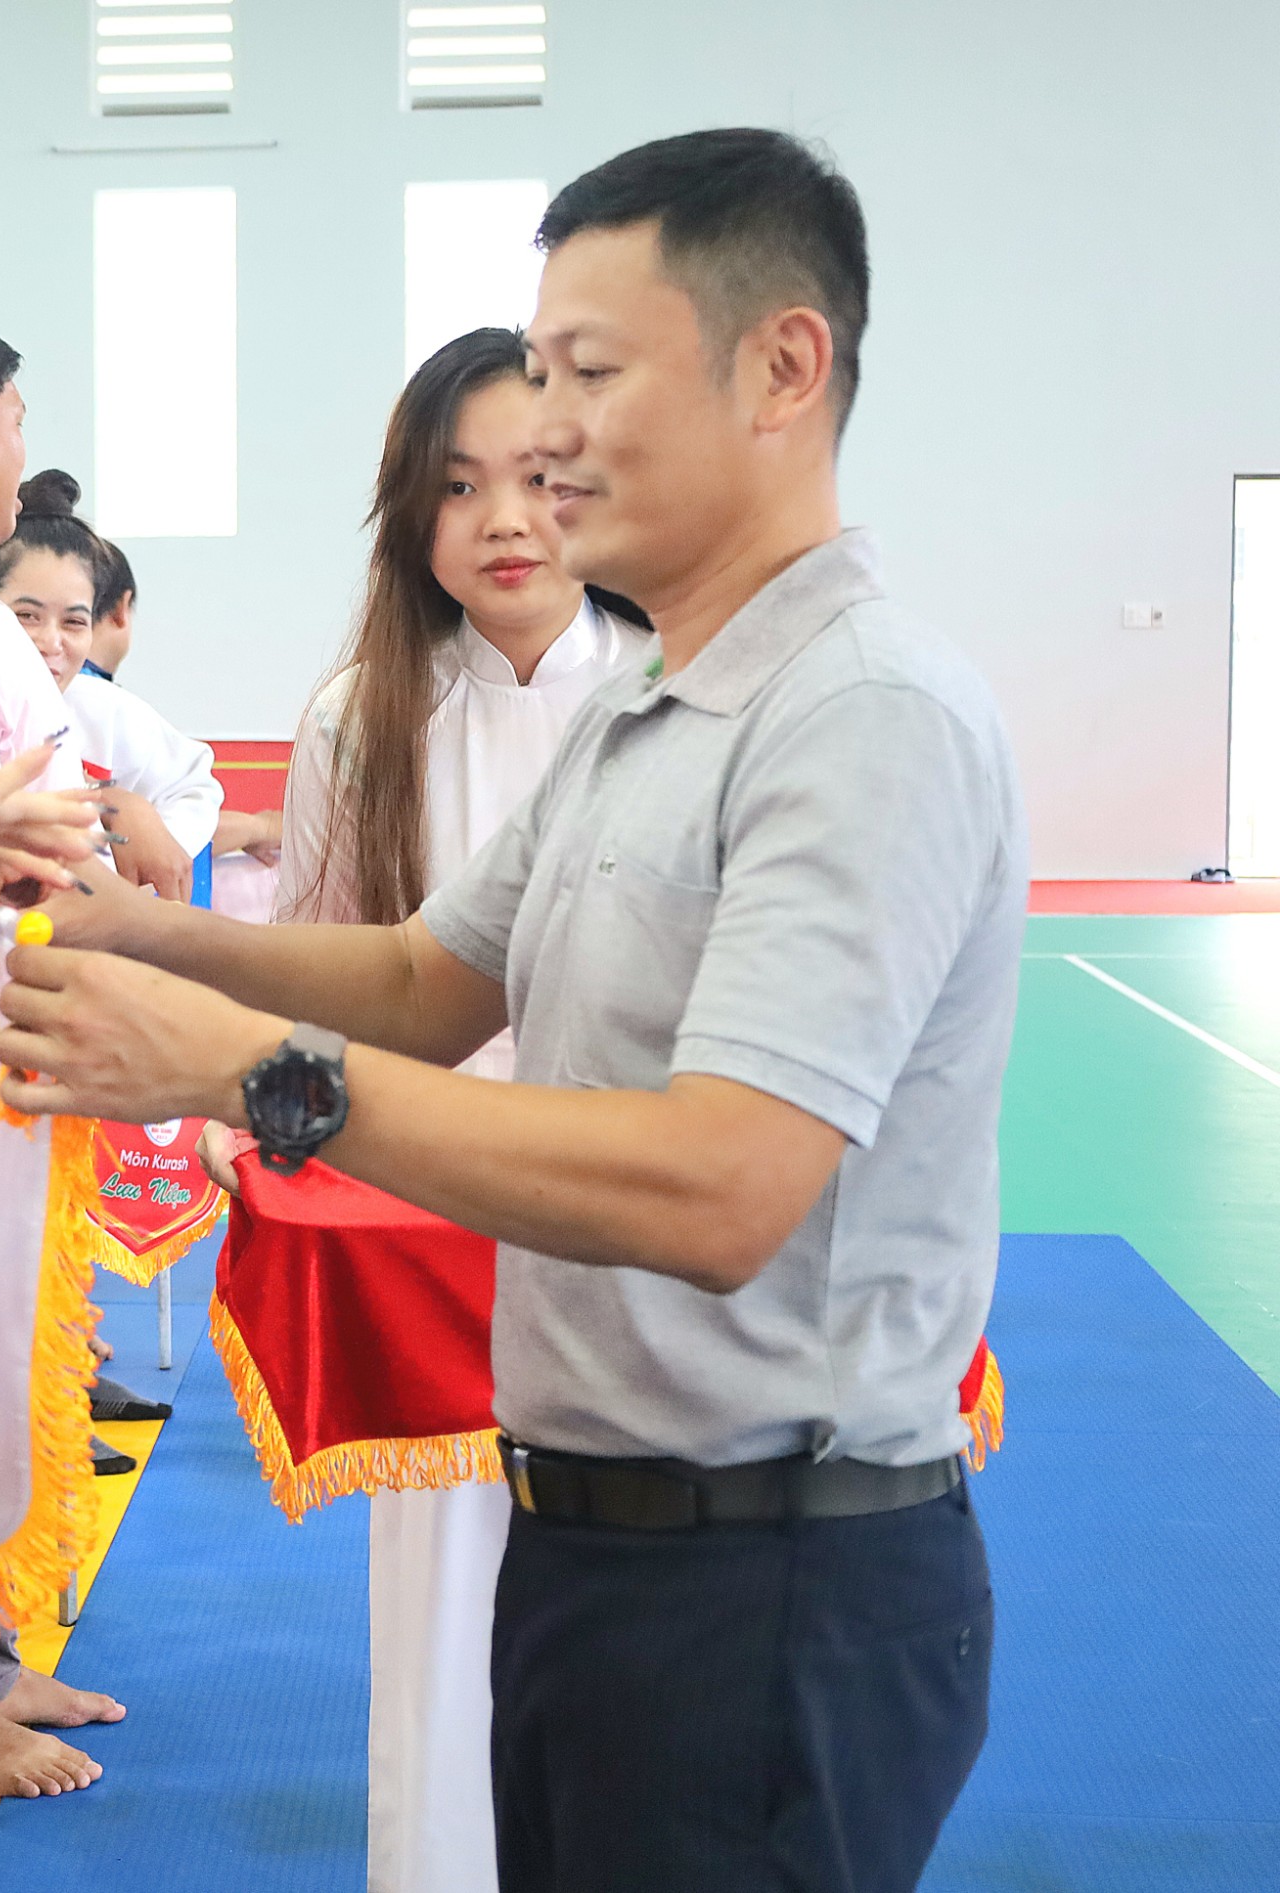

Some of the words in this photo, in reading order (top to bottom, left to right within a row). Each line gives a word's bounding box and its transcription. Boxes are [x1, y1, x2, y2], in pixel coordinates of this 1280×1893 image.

[120, 1148, 150, 1168] Môn
[151, 1153, 189, 1171] Kurash
[148, 1177, 192, 1210] Niệm
